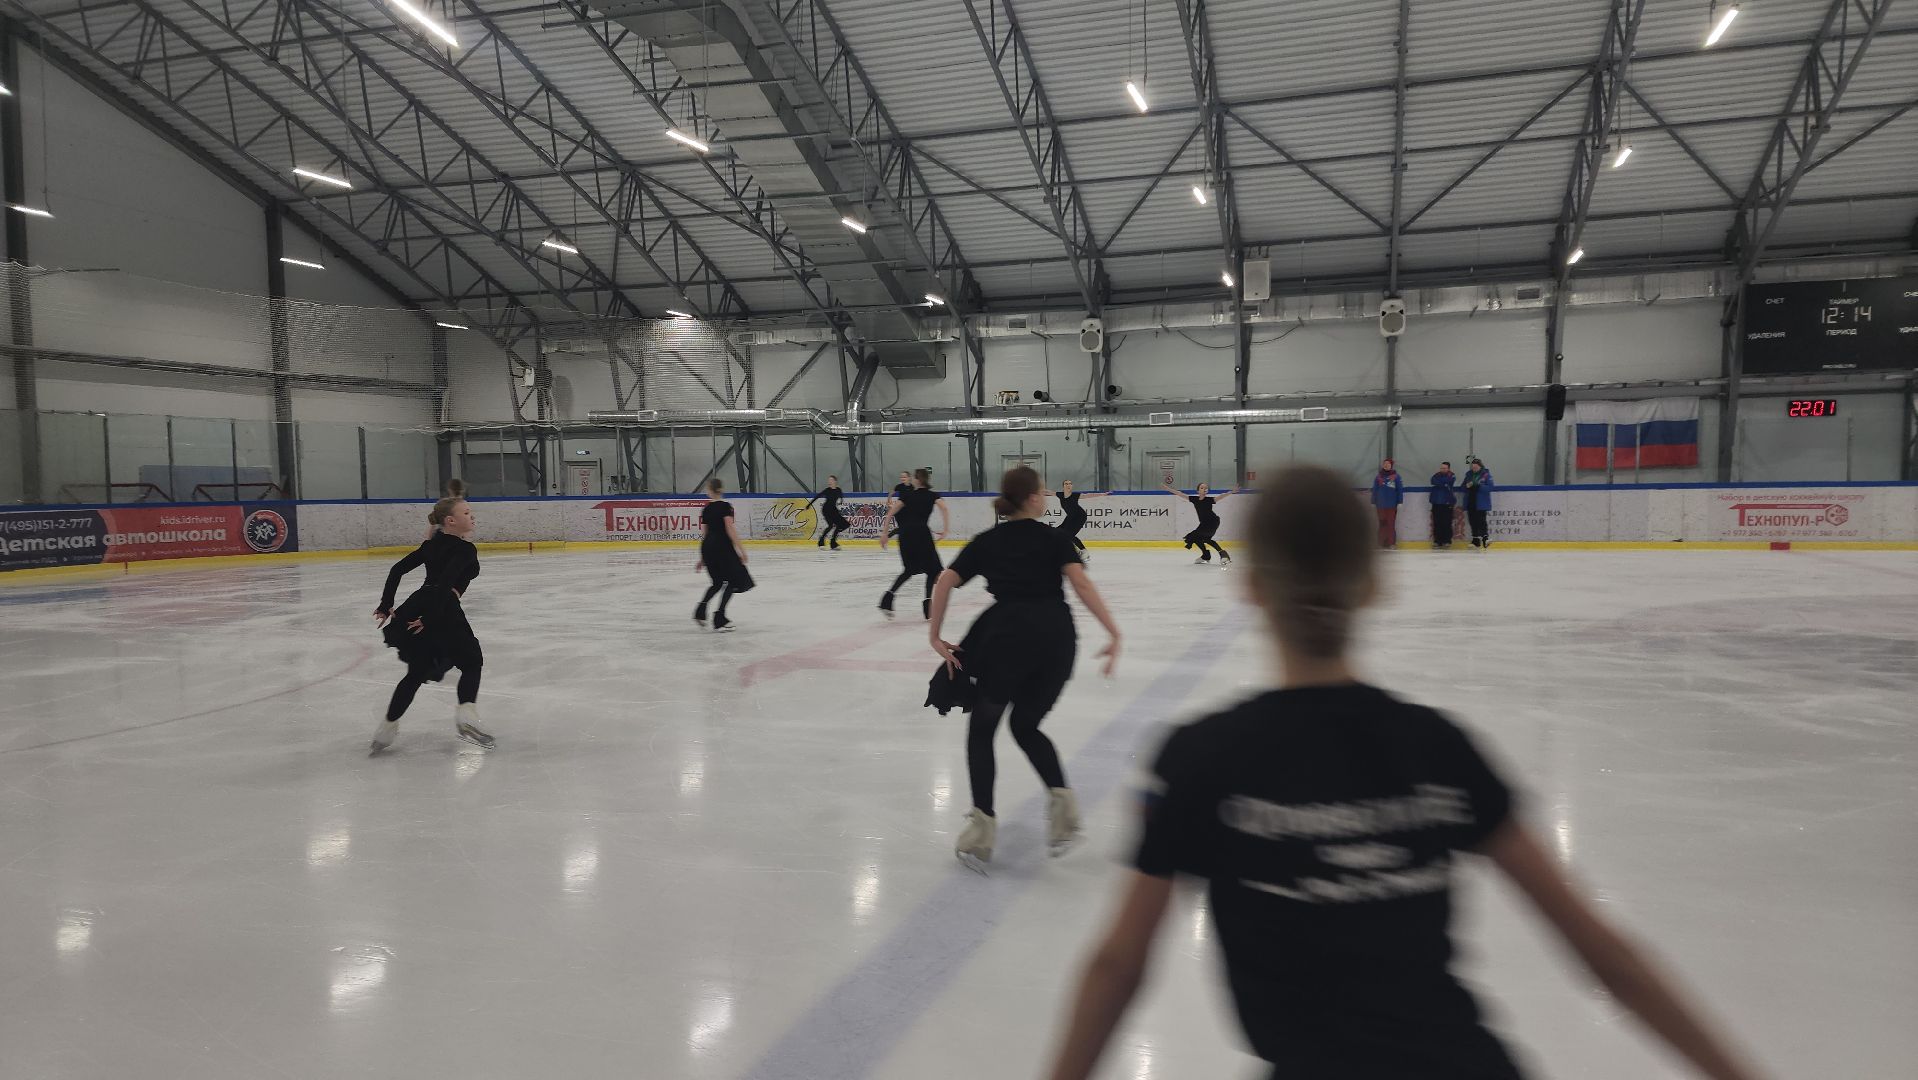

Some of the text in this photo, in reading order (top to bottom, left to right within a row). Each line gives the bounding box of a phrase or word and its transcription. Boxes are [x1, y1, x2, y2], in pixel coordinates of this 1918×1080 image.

[1765, 297, 1785, 305] СЧЕТ
[1829, 297, 1860, 305] ТАЙМЕР
[1821, 305, 1872, 324] 12:14
[1748, 331, 1786, 340] УДАЛЕНИЯ
[1826, 328, 1857, 336] ПЕРИОД
[1788, 494, 1835, 502] хоккейную
[1837, 494, 1864, 503] школу
[1044, 508, 1062, 517] АУ
[1119, 508, 1169, 517] ИМЕНИ
[1729, 504, 1825, 527] ТЕХНОПУЛ-Р
[160, 515, 227, 526] kids.idriver.ru
[1084, 519, 1137, 529] ПКИНА"
[1489, 518, 1545, 526] СКОВСКОЙ
[848, 527, 877, 536] Победа
[0, 528, 227, 556] Детская автошкола
